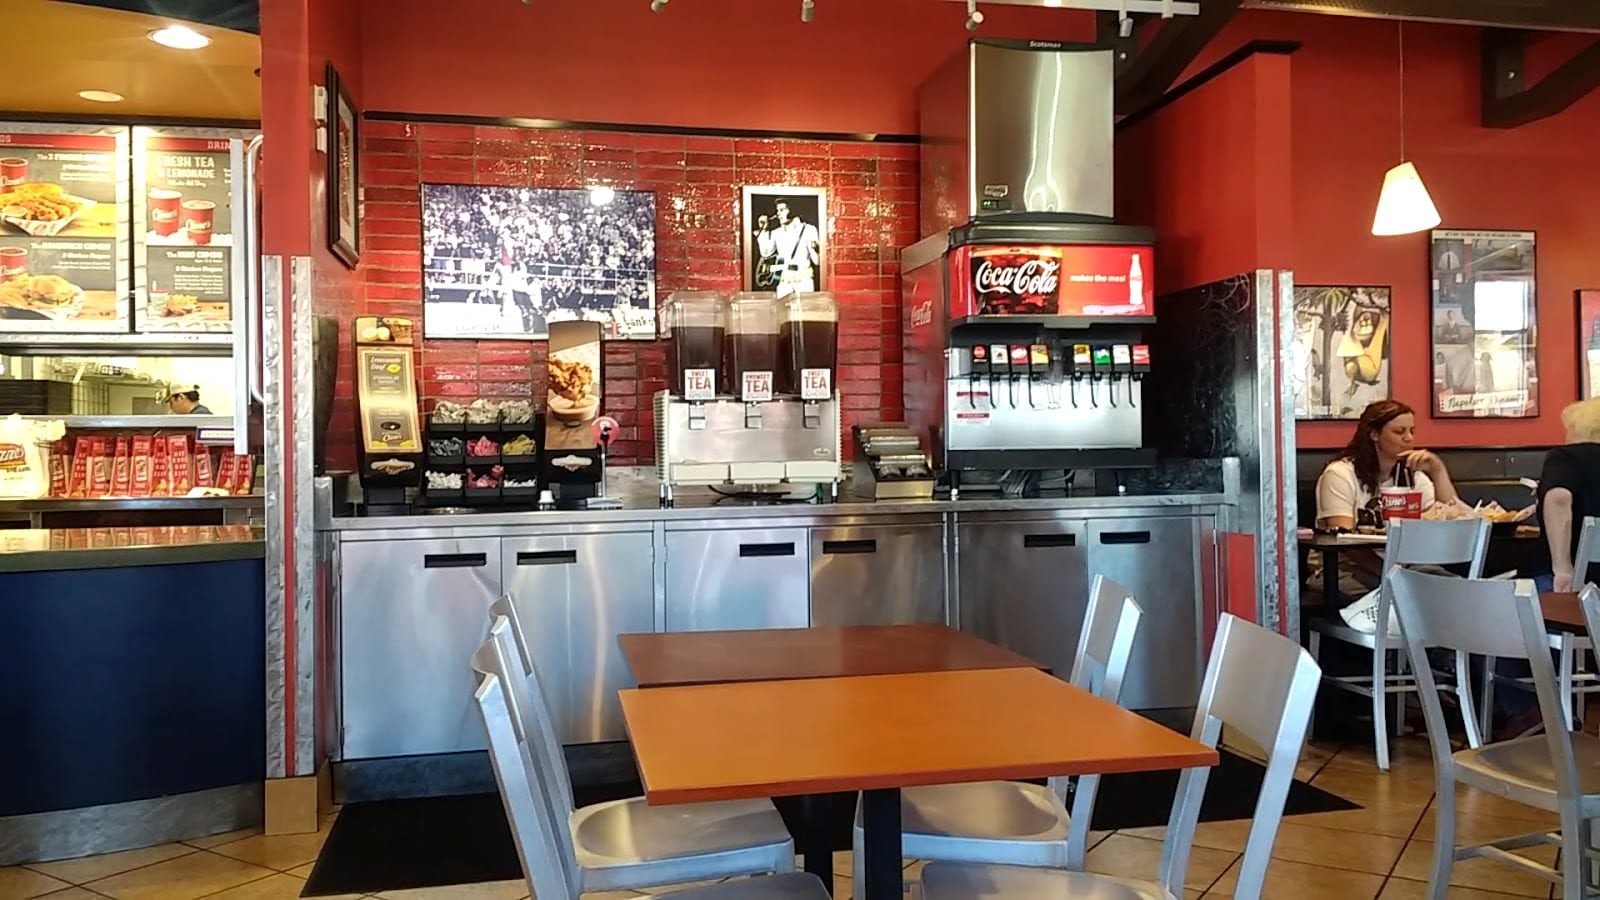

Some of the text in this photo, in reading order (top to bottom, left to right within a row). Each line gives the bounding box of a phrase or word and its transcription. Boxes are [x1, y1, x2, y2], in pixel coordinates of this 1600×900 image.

[1028, 40, 1062, 48] Scotsman
[194, 156, 215, 168] TEA
[167, 168, 215, 178] LEMONADE
[975, 259, 1060, 295] Coca-Cola
[1070, 274, 1093, 282] makes
[1094, 274, 1107, 282] the
[1108, 274, 1126, 282] meal
[687, 376, 712, 390] TEA
[745, 380, 770, 393] TEA
[804, 376, 827, 389] TEA
